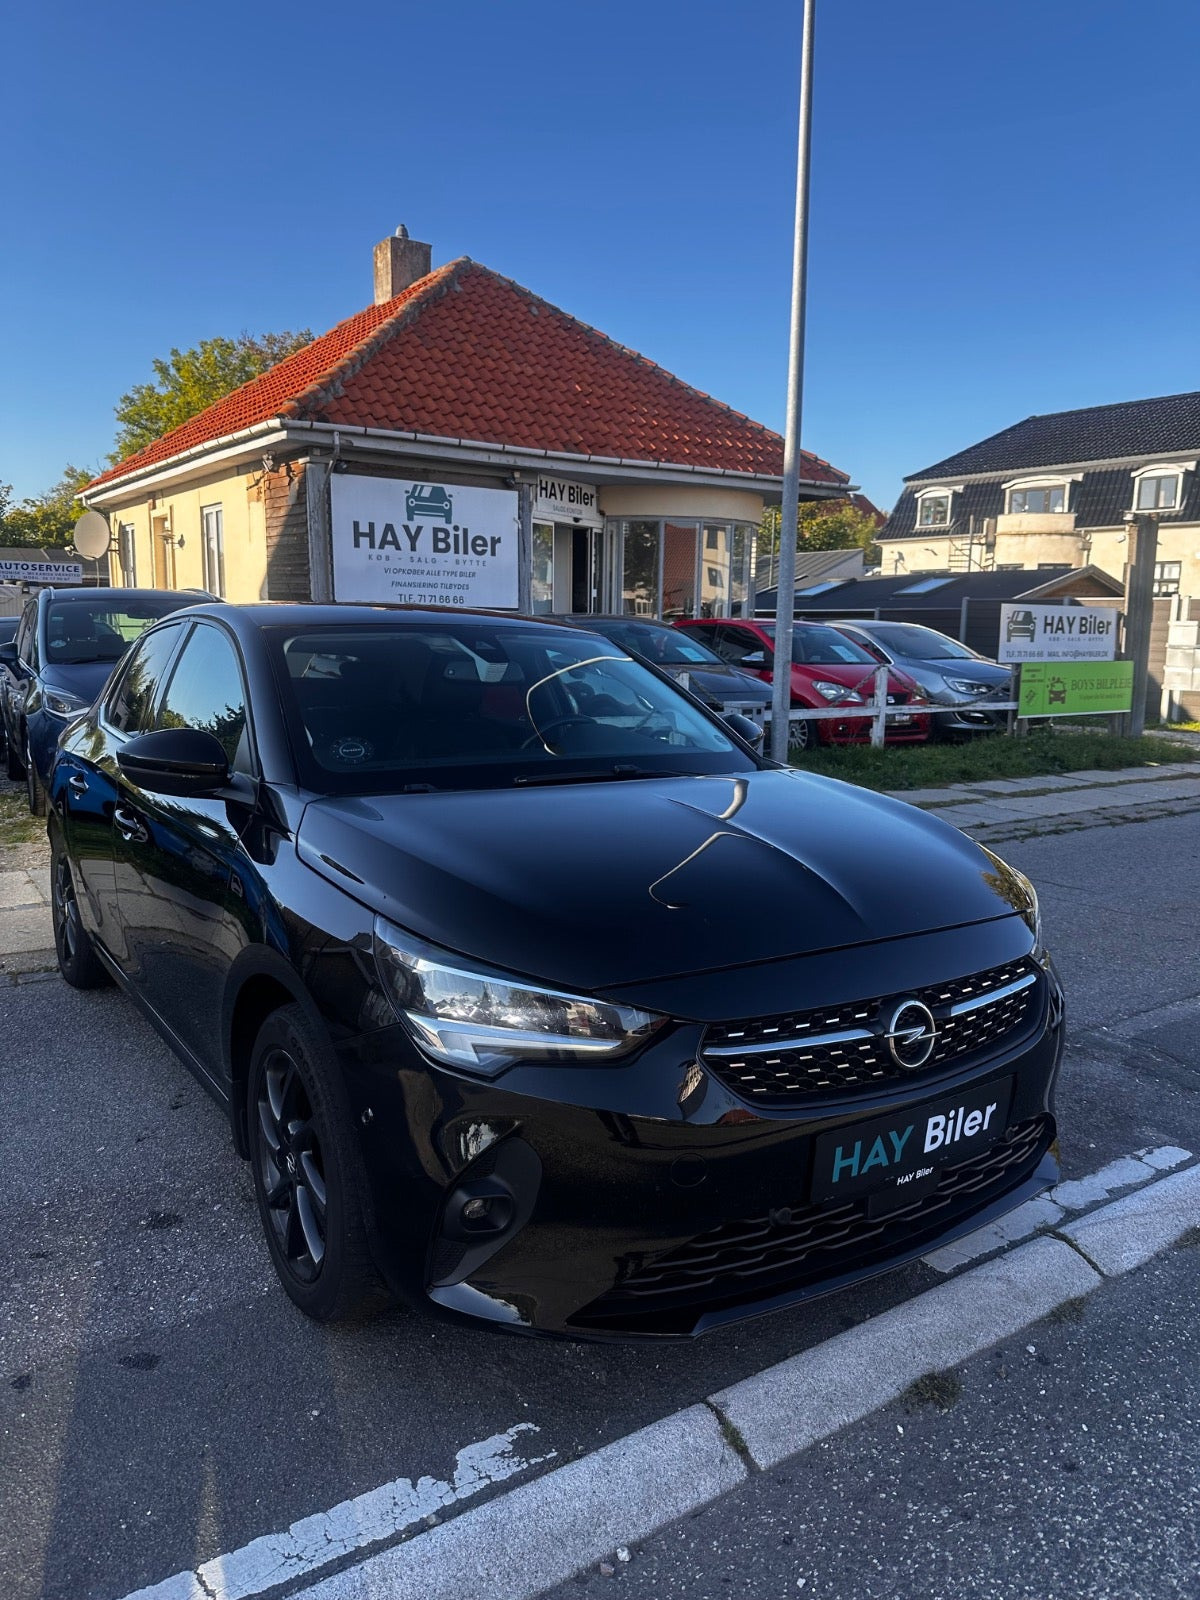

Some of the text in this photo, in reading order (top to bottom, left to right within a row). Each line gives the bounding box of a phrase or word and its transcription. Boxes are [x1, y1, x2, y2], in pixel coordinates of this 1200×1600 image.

[539, 479, 595, 507] HAY Biler
[352, 520, 502, 557] HAY Biler
[0, 562, 80, 573] AUTOSERVICE
[409, 556, 437, 564] SALG
[455, 559, 487, 567] BYTTE
[426, 569, 441, 577] ALLE
[440, 582, 470, 590] TILBYDES
[398, 593, 416, 603] TLF.
[1043, 615, 1112, 635] HAY Biler
[1071, 679, 1095, 691] BOYS
[831, 1102, 997, 1184] HAY Biler
[896, 1166, 934, 1186] HAY Biler
